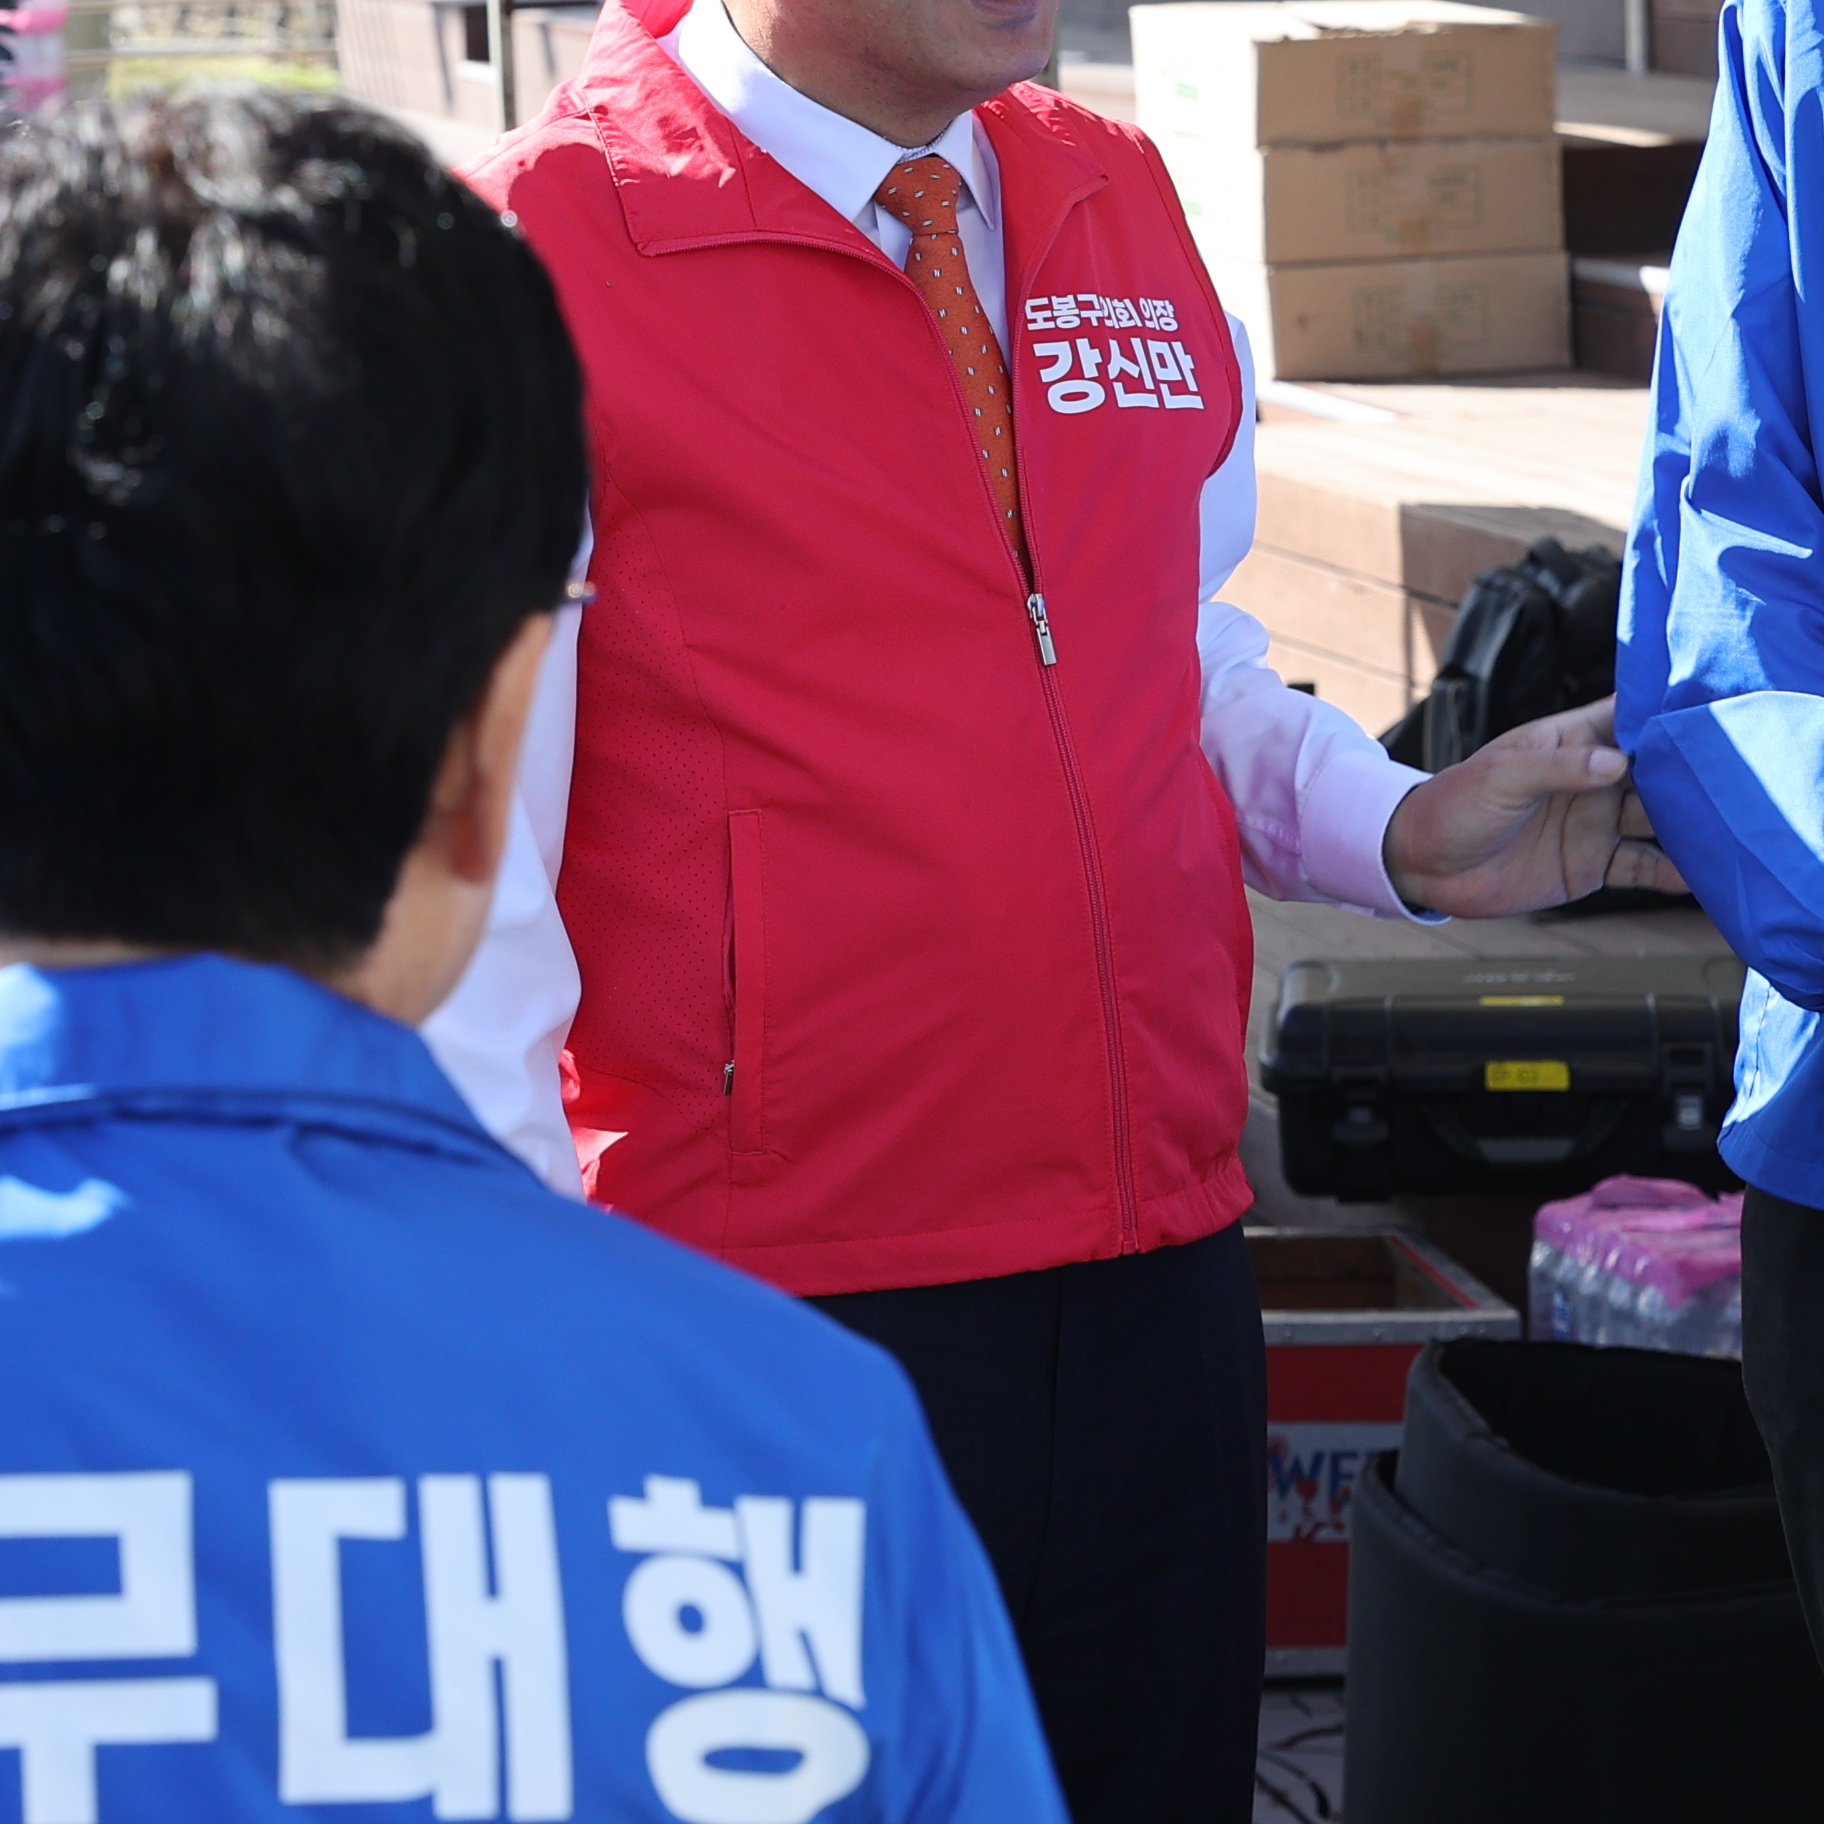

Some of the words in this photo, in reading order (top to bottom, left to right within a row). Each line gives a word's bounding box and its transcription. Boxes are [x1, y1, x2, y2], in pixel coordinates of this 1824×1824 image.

[1025, 293, 1143, 331] 도봉구의회
[1139, 297, 1179, 331] 의장
[1033, 337, 1205, 414] 강신만
